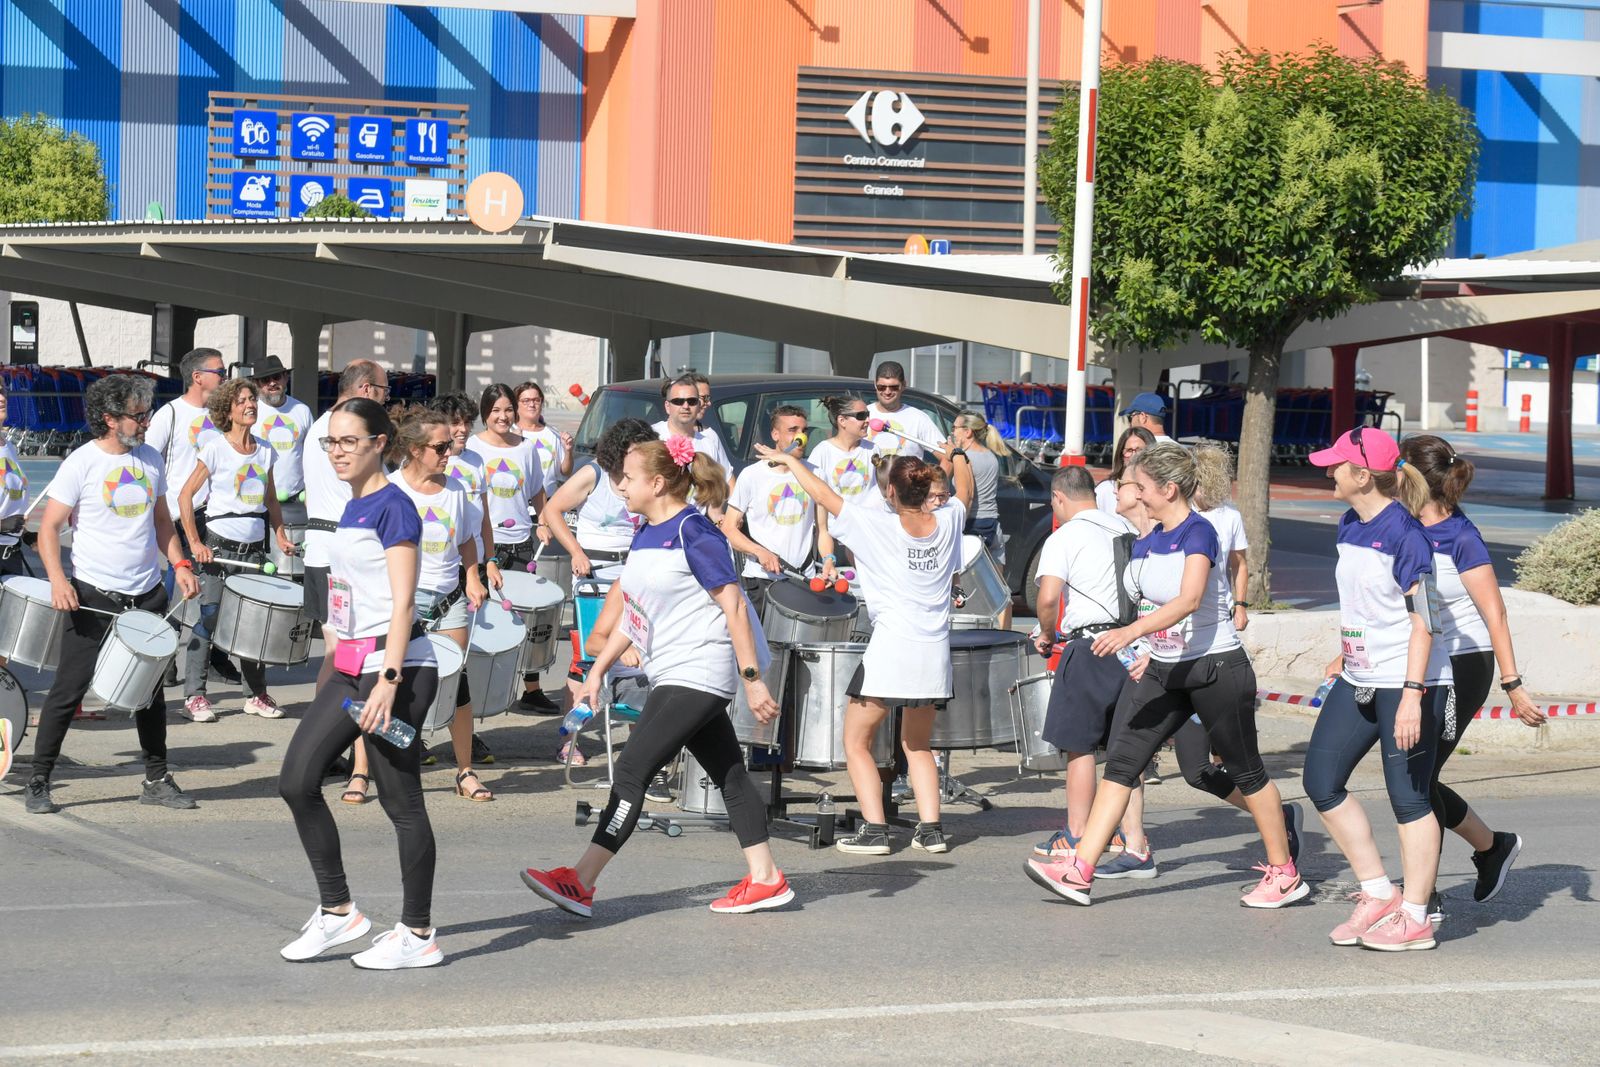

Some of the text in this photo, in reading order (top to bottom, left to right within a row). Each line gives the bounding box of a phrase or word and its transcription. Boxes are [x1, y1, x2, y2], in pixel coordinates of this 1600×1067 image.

[355, 152, 385, 160] Gasolinera
[409, 154, 444, 162] Restauración
[843, 155, 925, 168] Centro Comercial
[863, 184, 904, 196] Granada
[484, 187, 507, 217] H
[233, 208, 275, 216] Complementos
[604, 799, 633, 837] PUMA
